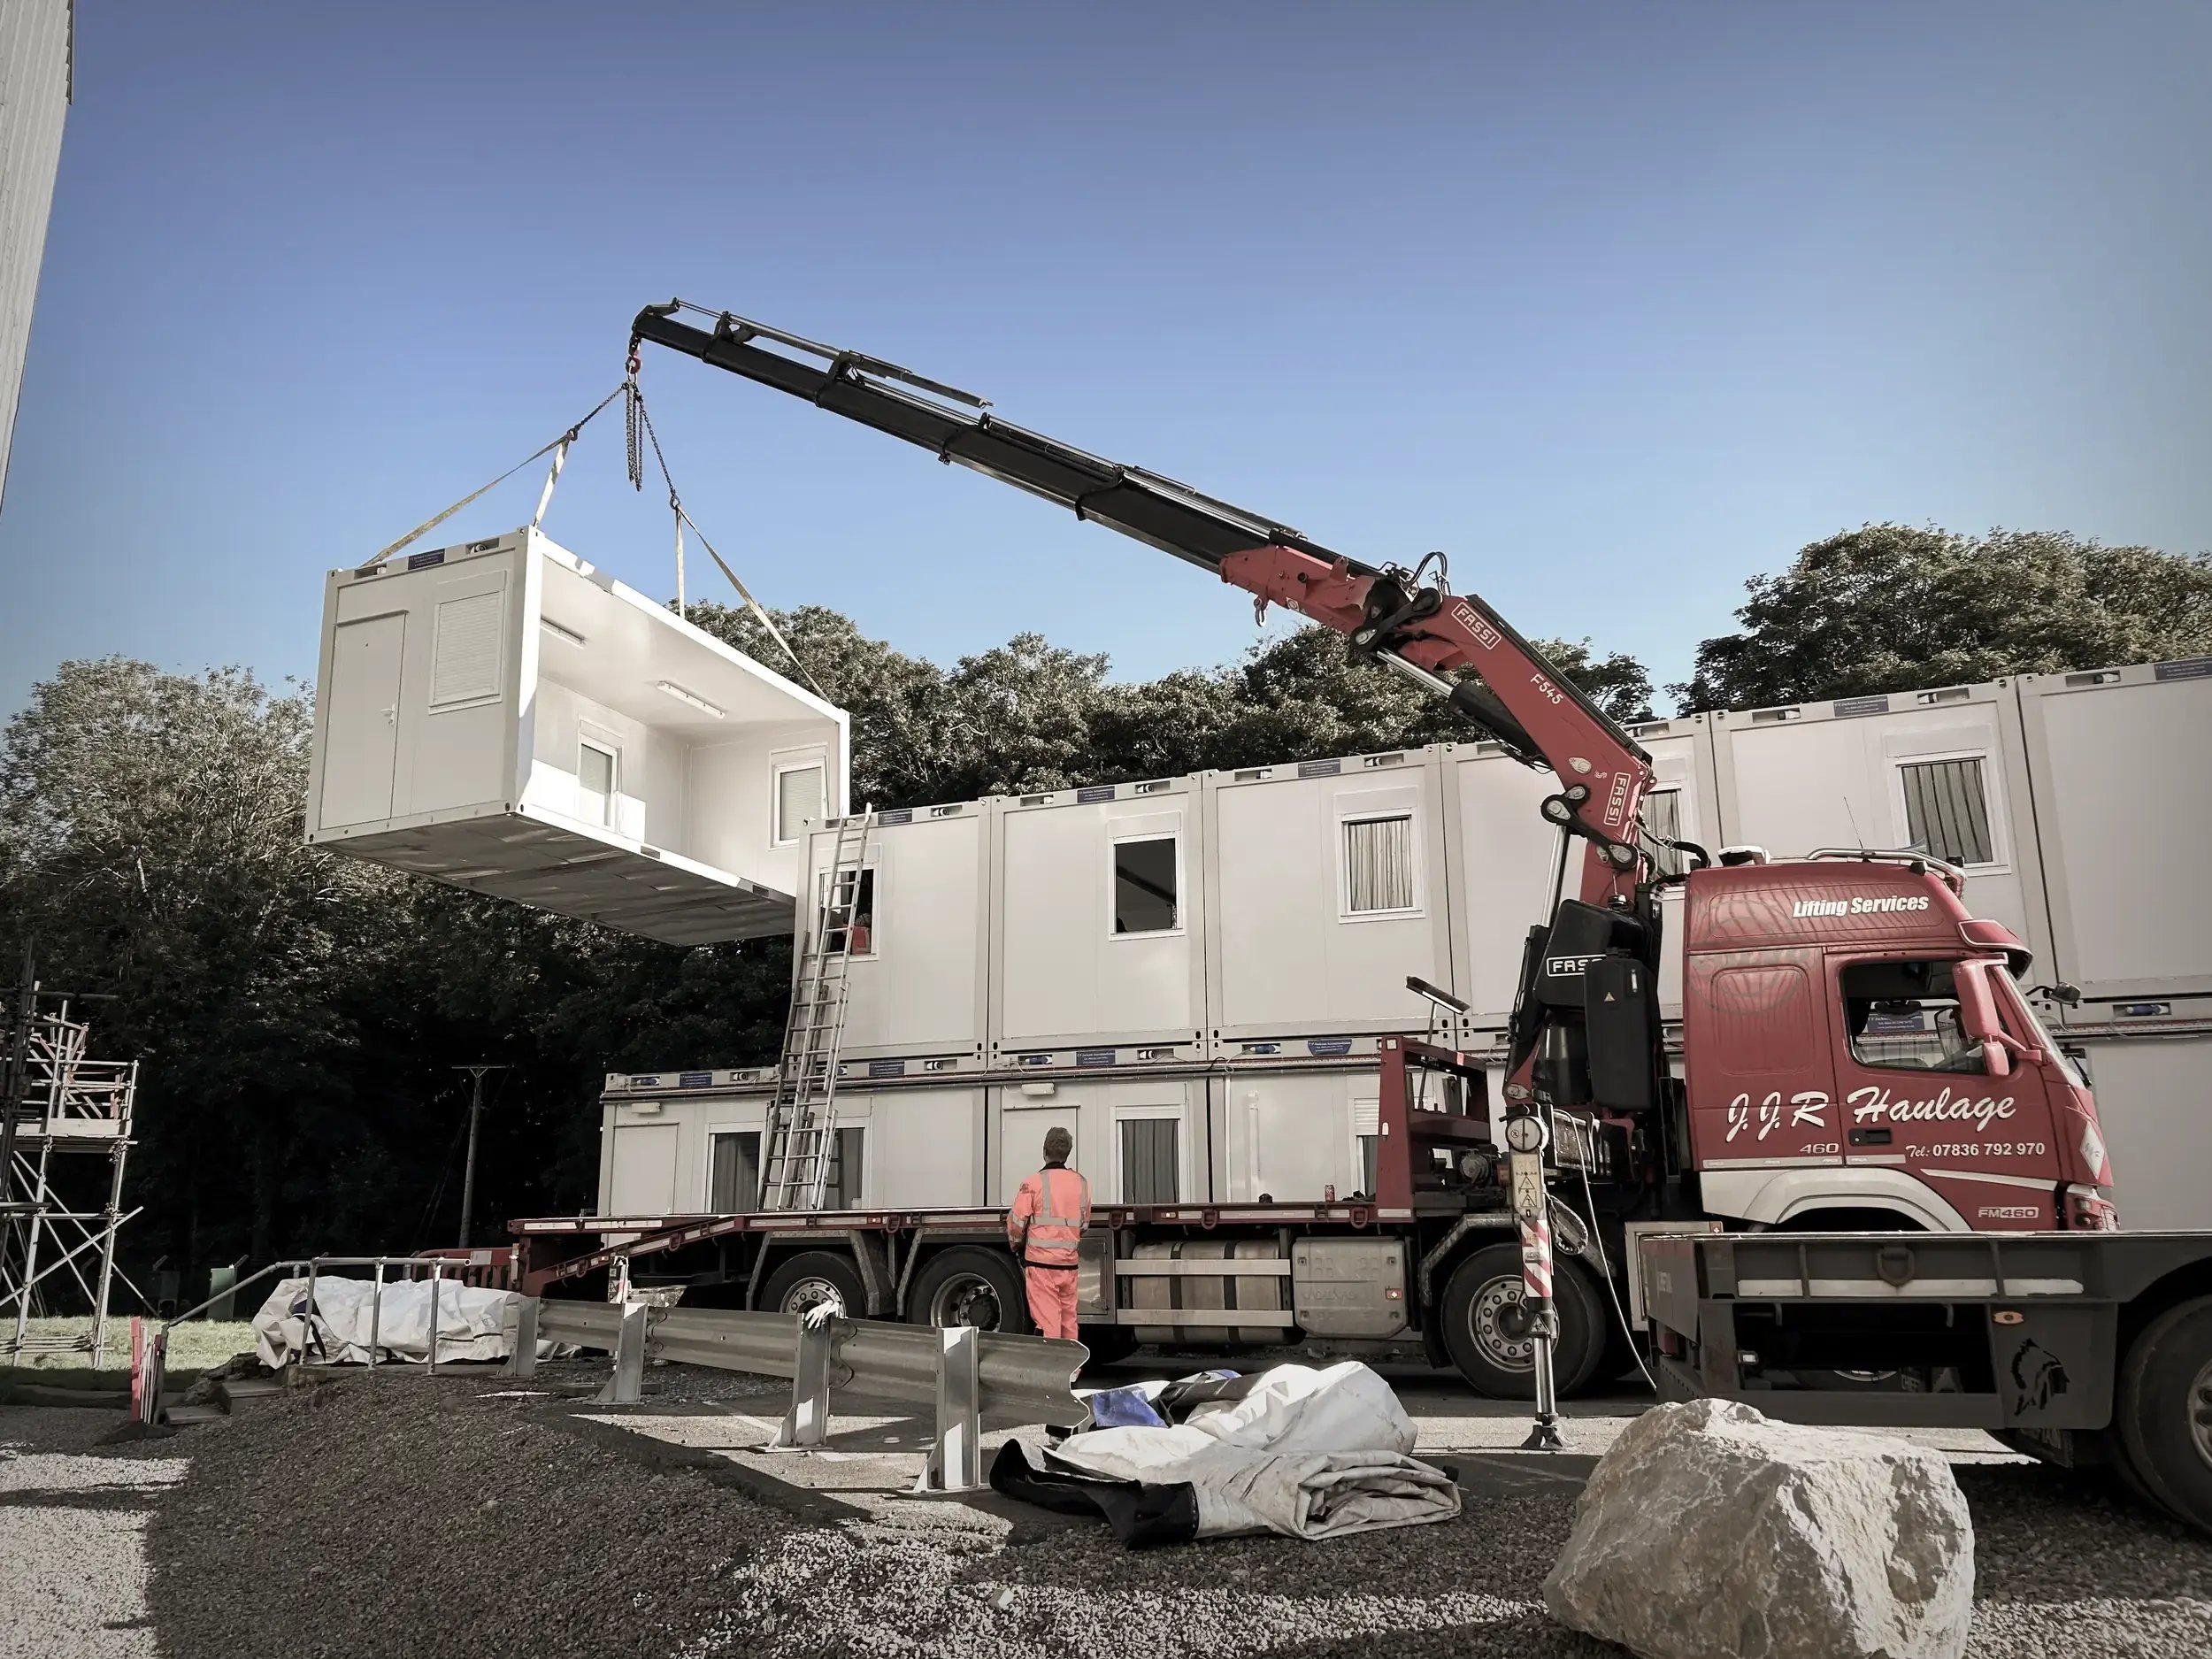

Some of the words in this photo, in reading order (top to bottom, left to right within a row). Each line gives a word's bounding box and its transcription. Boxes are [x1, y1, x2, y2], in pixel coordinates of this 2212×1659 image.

[1456, 608, 1496, 644] FASSI
[1530, 673, 1563, 704] F545
[1608, 777, 1627, 821] FASSI
[1793, 899, 1848, 918] Lifting
[1850, 895, 1930, 914] Services
[1553, 958, 1602, 972] FAS
[1847, 1086, 2016, 1133] Haulage
[1800, 1143, 1839, 1154] 460
[1905, 1145, 1930, 1158] Tel:
[1932, 1144, 1979, 1156] 07836
[1984, 1143, 2012, 1156] 792
[2016, 1142, 2046, 1156] 970
[1978, 1206, 2039, 1218] FM460
